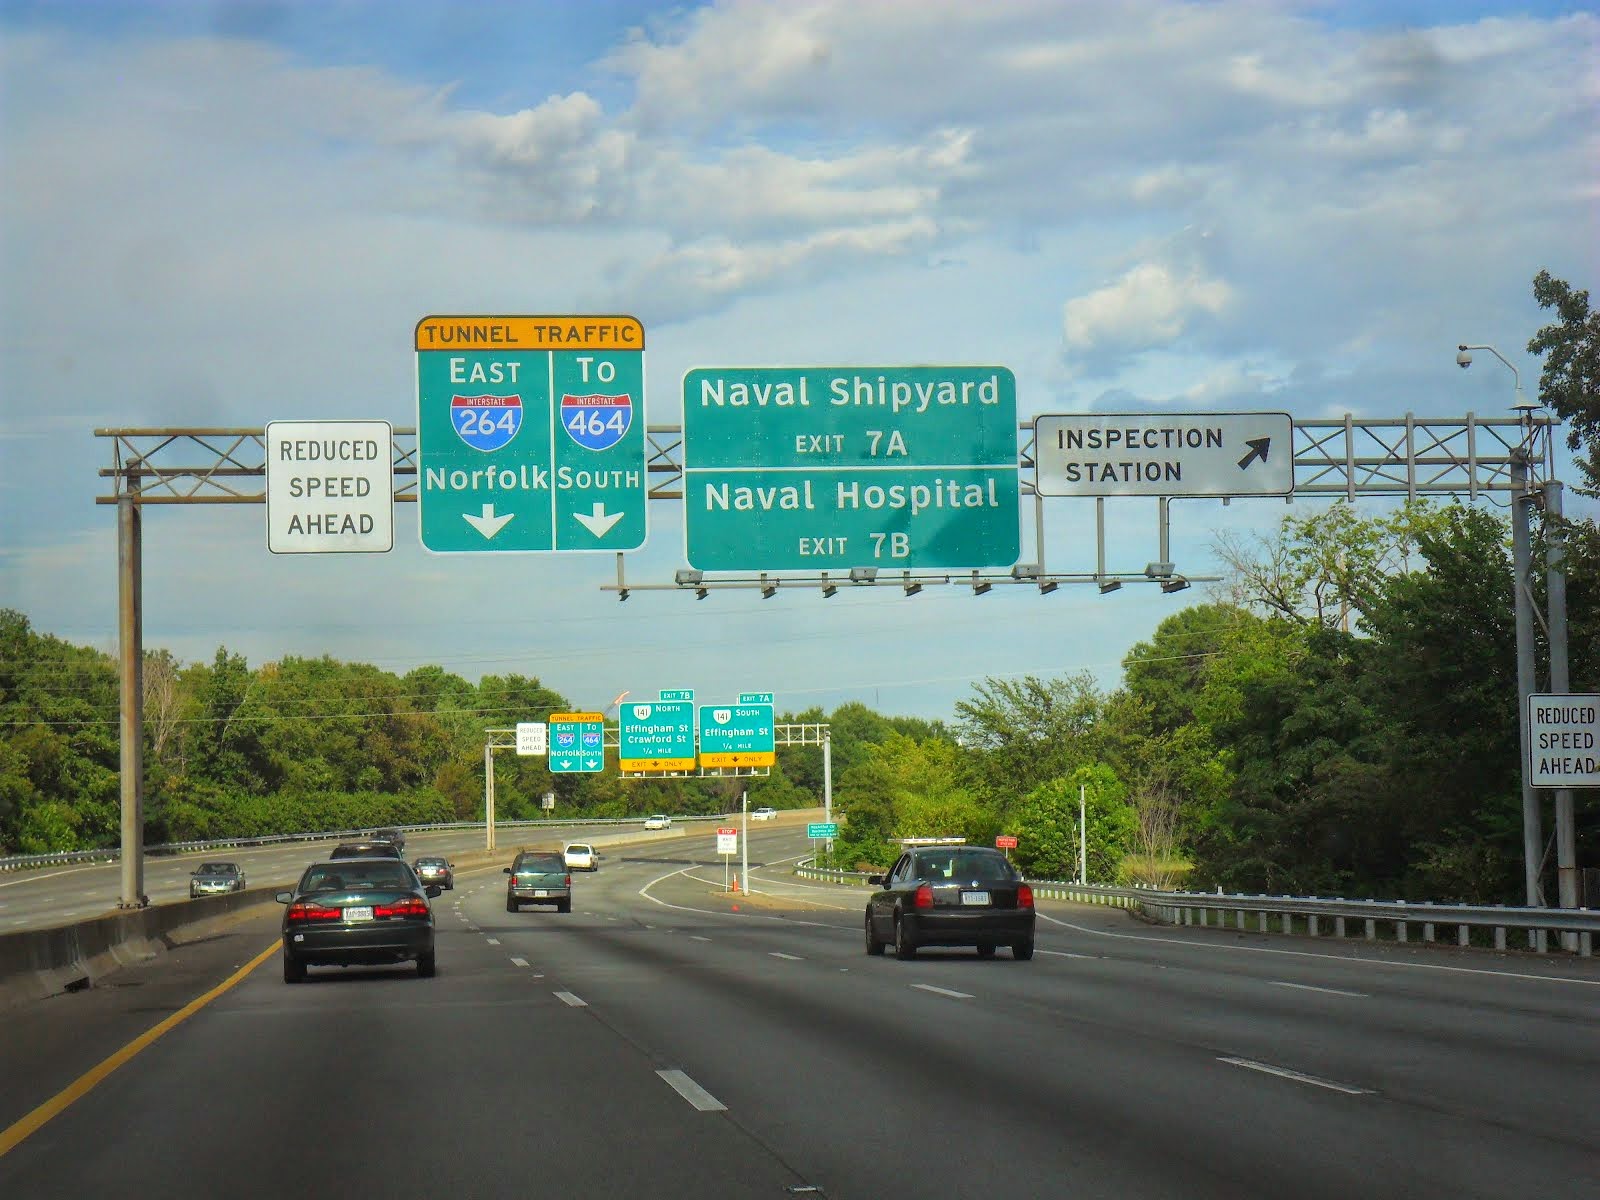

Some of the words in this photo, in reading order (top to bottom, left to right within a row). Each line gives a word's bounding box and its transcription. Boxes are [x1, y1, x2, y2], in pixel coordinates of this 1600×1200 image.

[425, 325, 518, 343] TUNNEL
[534, 325, 634, 343] TRAFFIC
[449, 358, 521, 384] EAST
[466, 398, 506, 406] INTERSTATE
[576, 397, 616, 406] INTERSTATE
[701, 376, 809, 406] Naval
[830, 376, 999, 412] Shipyard
[460, 409, 516, 435] 264
[568, 409, 625, 435] 464
[795, 434, 844, 454] EXIT
[866, 430, 908, 456] 7A
[1058, 428, 1223, 450] INSPECTION
[280, 440, 378, 461] REDUCED
[426, 464, 549, 490] Norfolk
[558, 466, 640, 488] SOUTH
[1066, 462, 1182, 482] STATION
[289, 477, 372, 498] SPEED
[705, 481, 814, 510] Naval
[837, 479, 999, 515] Hospital
[288, 514, 374, 535] AHEAD
[799, 537, 848, 556] EXIT
[870, 532, 910, 558] 7B
[637, 708, 648, 716] 141
[1537, 708, 1595, 724] REDUCED
[626, 724, 674, 734] Effingham
[628, 735, 672, 743] Crawford
[705, 728, 754, 738] Effingham
[1540, 733, 1593, 749] SPEED
[1540, 758, 1595, 774] AHEAD
